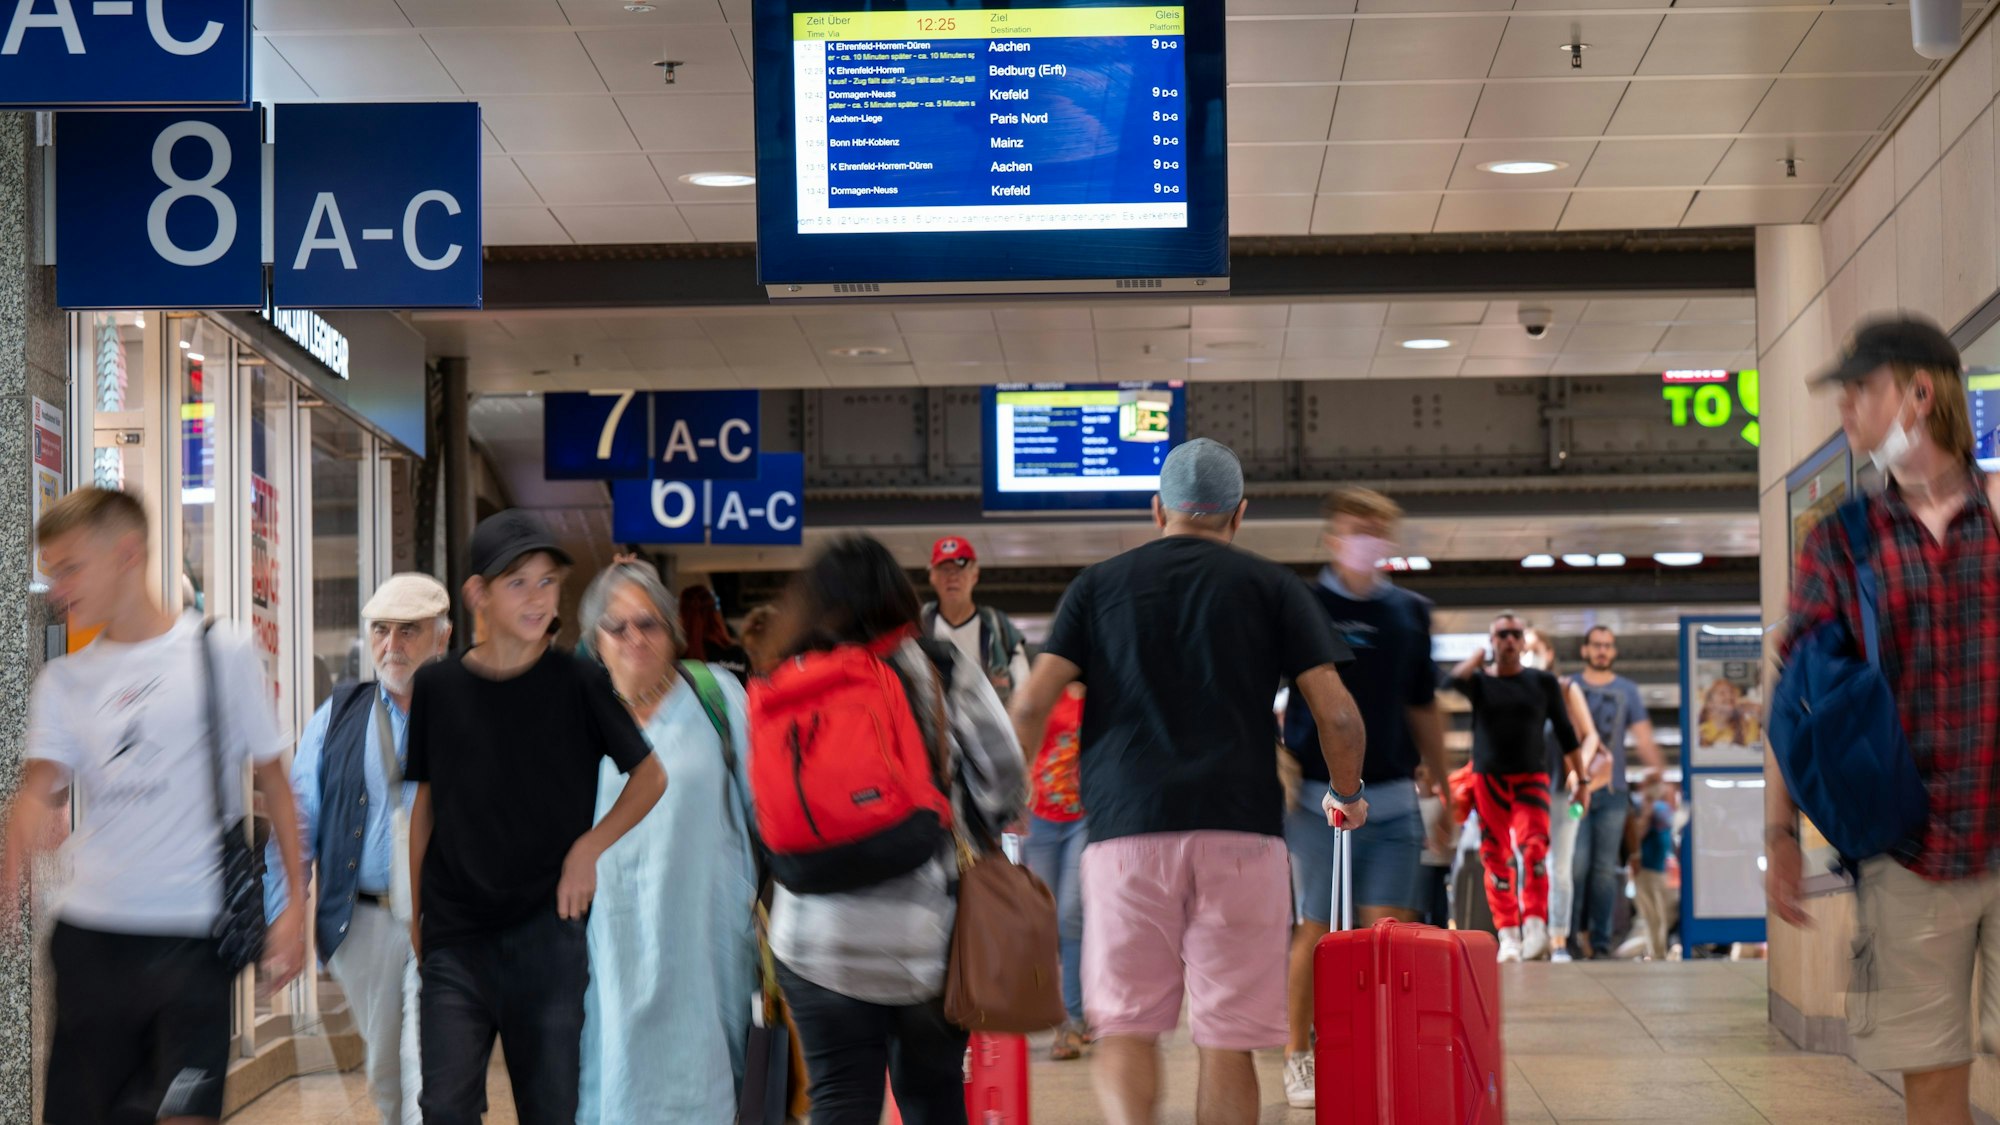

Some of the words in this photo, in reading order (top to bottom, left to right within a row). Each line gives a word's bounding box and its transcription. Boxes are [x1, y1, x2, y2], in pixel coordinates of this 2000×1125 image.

[807, 17, 824, 25] Zeit
[828, 15, 850, 24] Über
[991, 14, 1008, 22] Ziel
[1156, 11, 1179, 19] Gleis
[1, 0, 224, 55] A-C
[917, 18, 956, 31] 12:25
[836, 42, 930, 50] Ehrenfeld-Horrem-Düren
[989, 41, 1030, 52] Aachen
[1152, 40, 1159, 48] 9
[837, 66, 904, 75] Ehrenfeld-Horrem
[989, 66, 1035, 77] Bedburg
[1038, 65, 1066, 76] (Erft)
[829, 90, 896, 100] Dormagen-Neuss
[990, 89, 1028, 100] Krefeld
[1152, 87, 1160, 97] 9
[829, 115, 882, 124] Aachen-Liege
[990, 114, 1018, 124] Paris
[1022, 113, 1048, 123] Nord
[1153, 111, 1160, 121] 8
[852, 138, 899, 147] Hbf-Koblenz
[991, 138, 1024, 148] Mainz
[1153, 136, 1160, 145] 9
[839, 162, 933, 171] Ehrenfeld-Horrem-Düren
[991, 162, 1032, 173] Aachen
[1154, 160, 1161, 169] 9
[831, 186, 898, 196] Dormagen-Neuss
[992, 185, 1030, 196] Krefeld
[1154, 183, 1161, 193] 9
[146, 120, 237, 267] 8
[293, 190, 462, 270] A-C
[1662, 384, 1732, 427] TO
[588, 390, 636, 460] 7
[662, 418, 752, 464] A-C
[651, 479, 696, 528] 6
[717, 491, 797, 531] A-C
